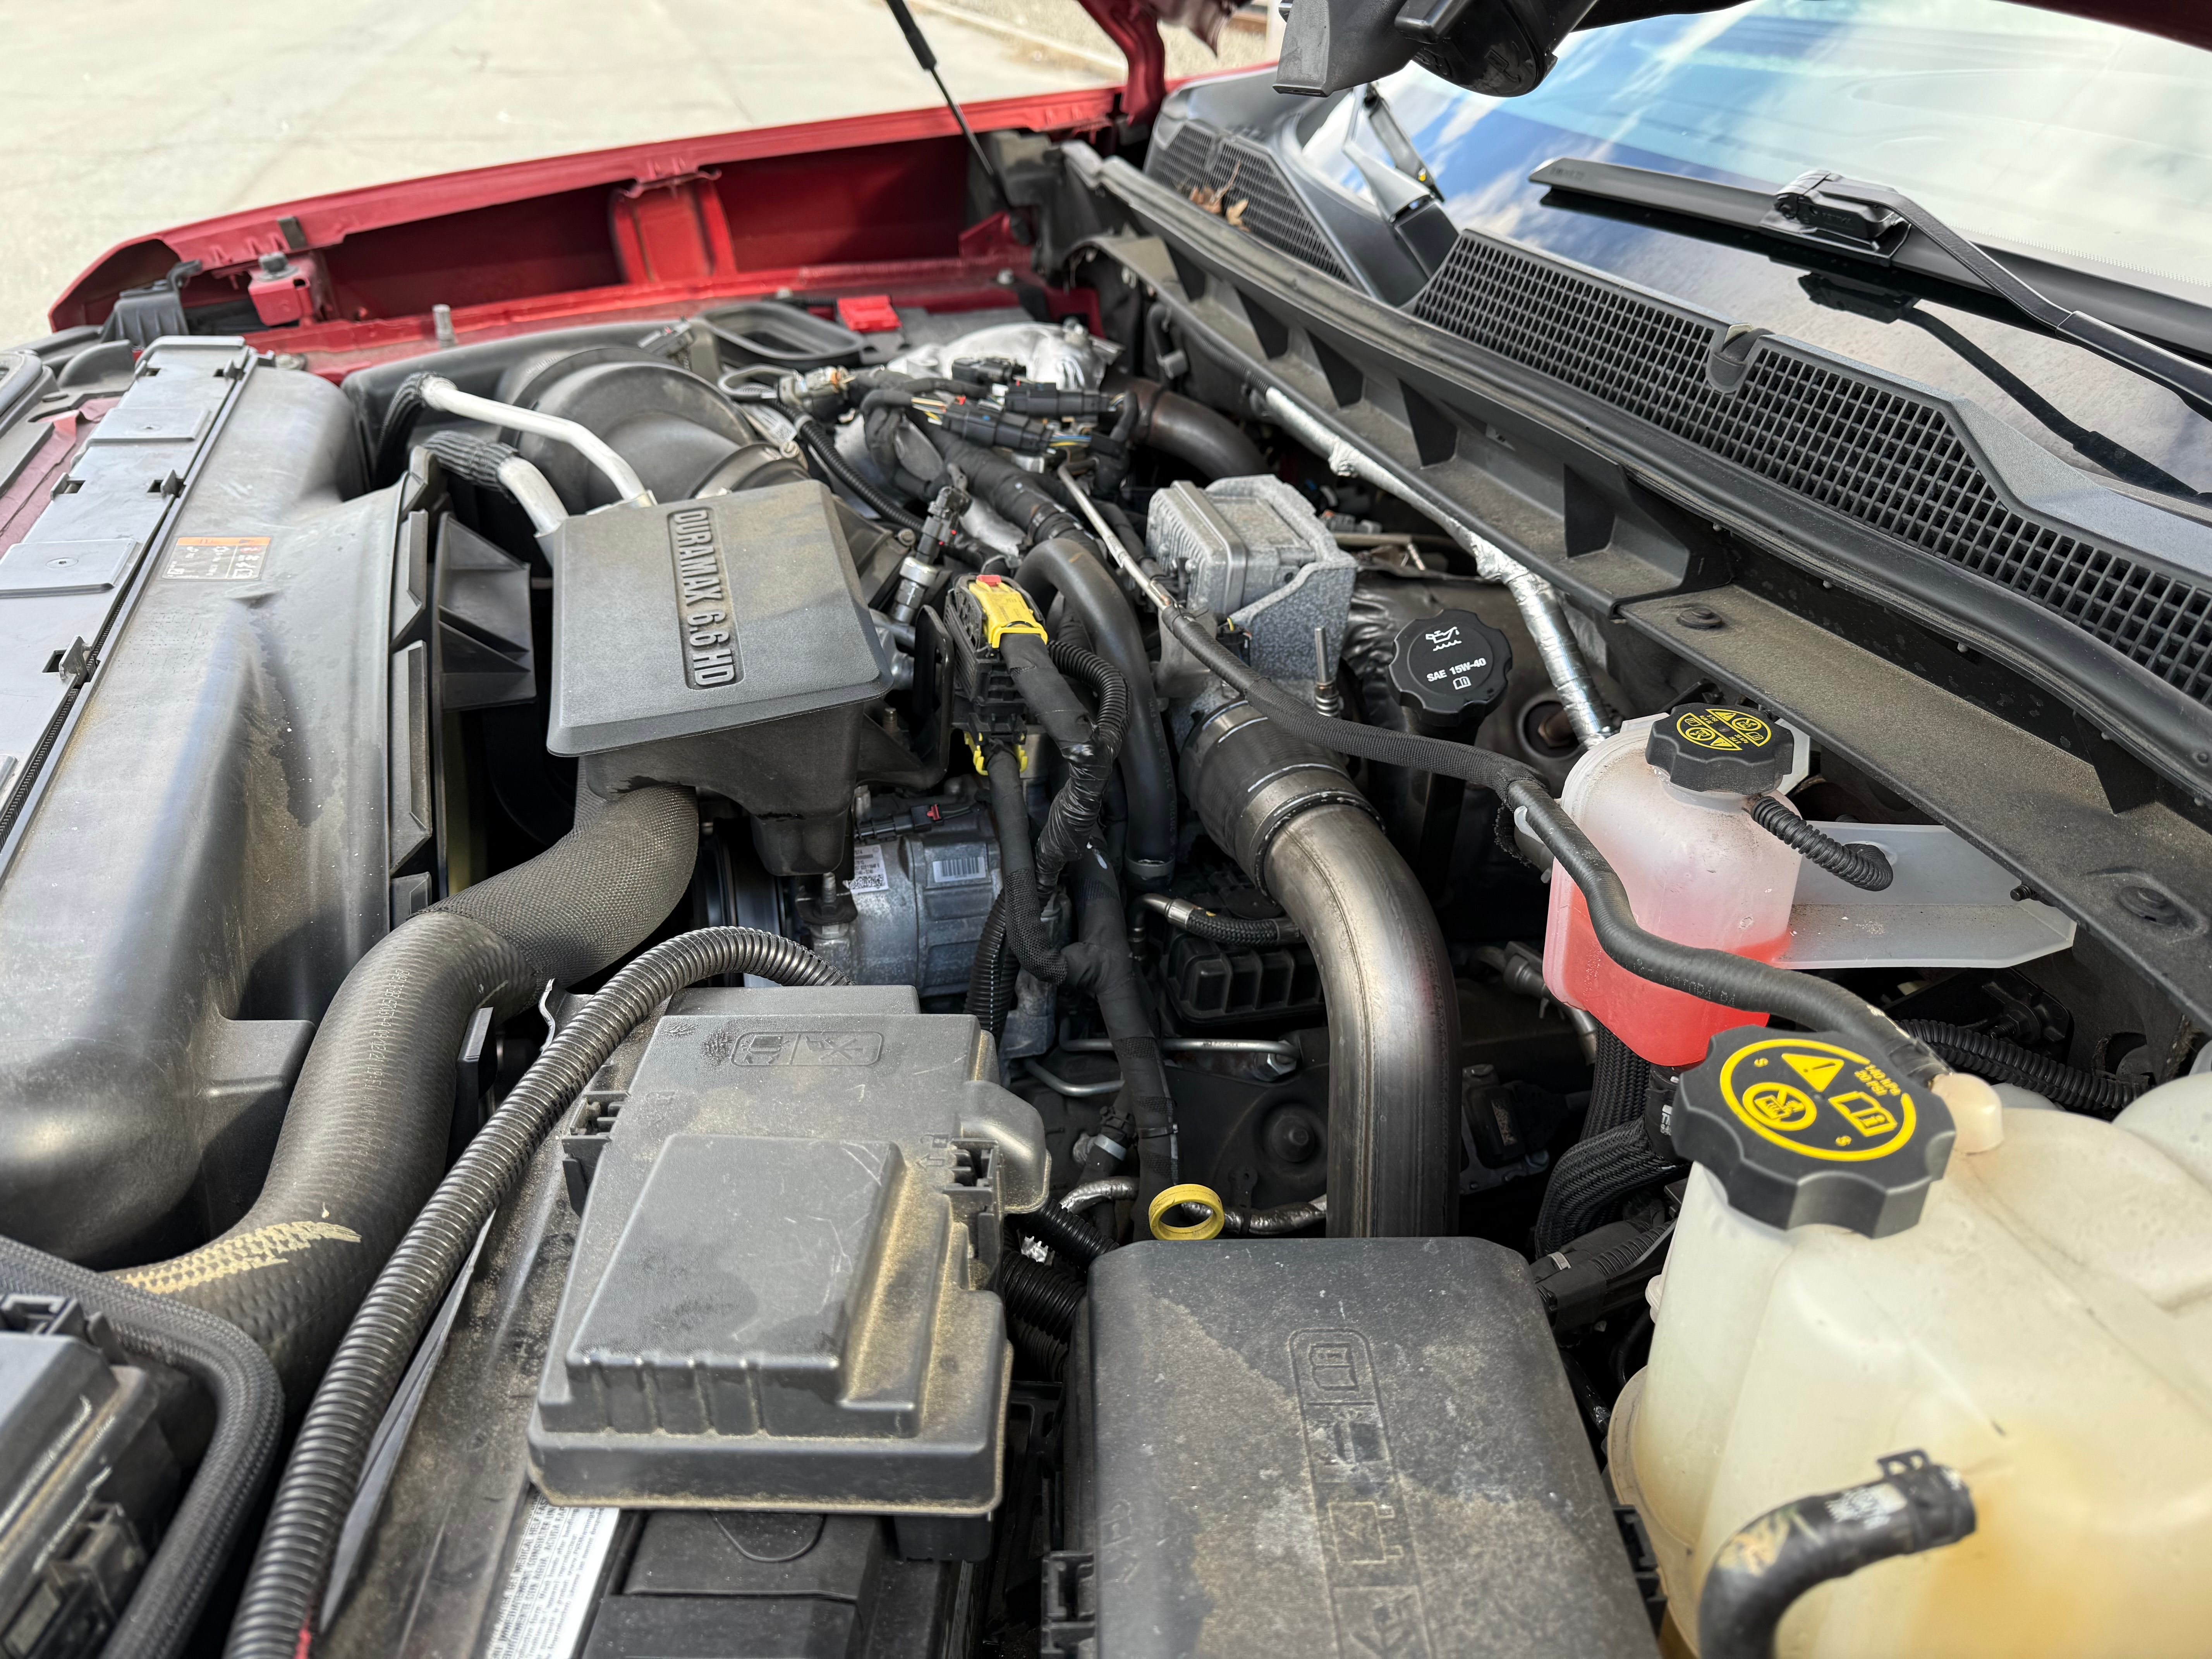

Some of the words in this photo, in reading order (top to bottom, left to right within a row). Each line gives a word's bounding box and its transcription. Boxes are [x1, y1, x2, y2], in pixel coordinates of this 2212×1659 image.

[674, 510, 724, 606] DURAMAX
[687, 609, 730, 646] 6.6
[693, 648, 735, 687] HD
[1427, 669, 1448, 682] SAE
[1449, 658, 1487, 675] 15W-40
[1855, 1070, 1872, 1082] 20
[1866, 1081, 1888, 1096] PSI
[1865, 1064, 1886, 1081] 140
[1880, 1078, 1901, 1096] kPa
[514, 1539, 534, 1573] MEDICAL
